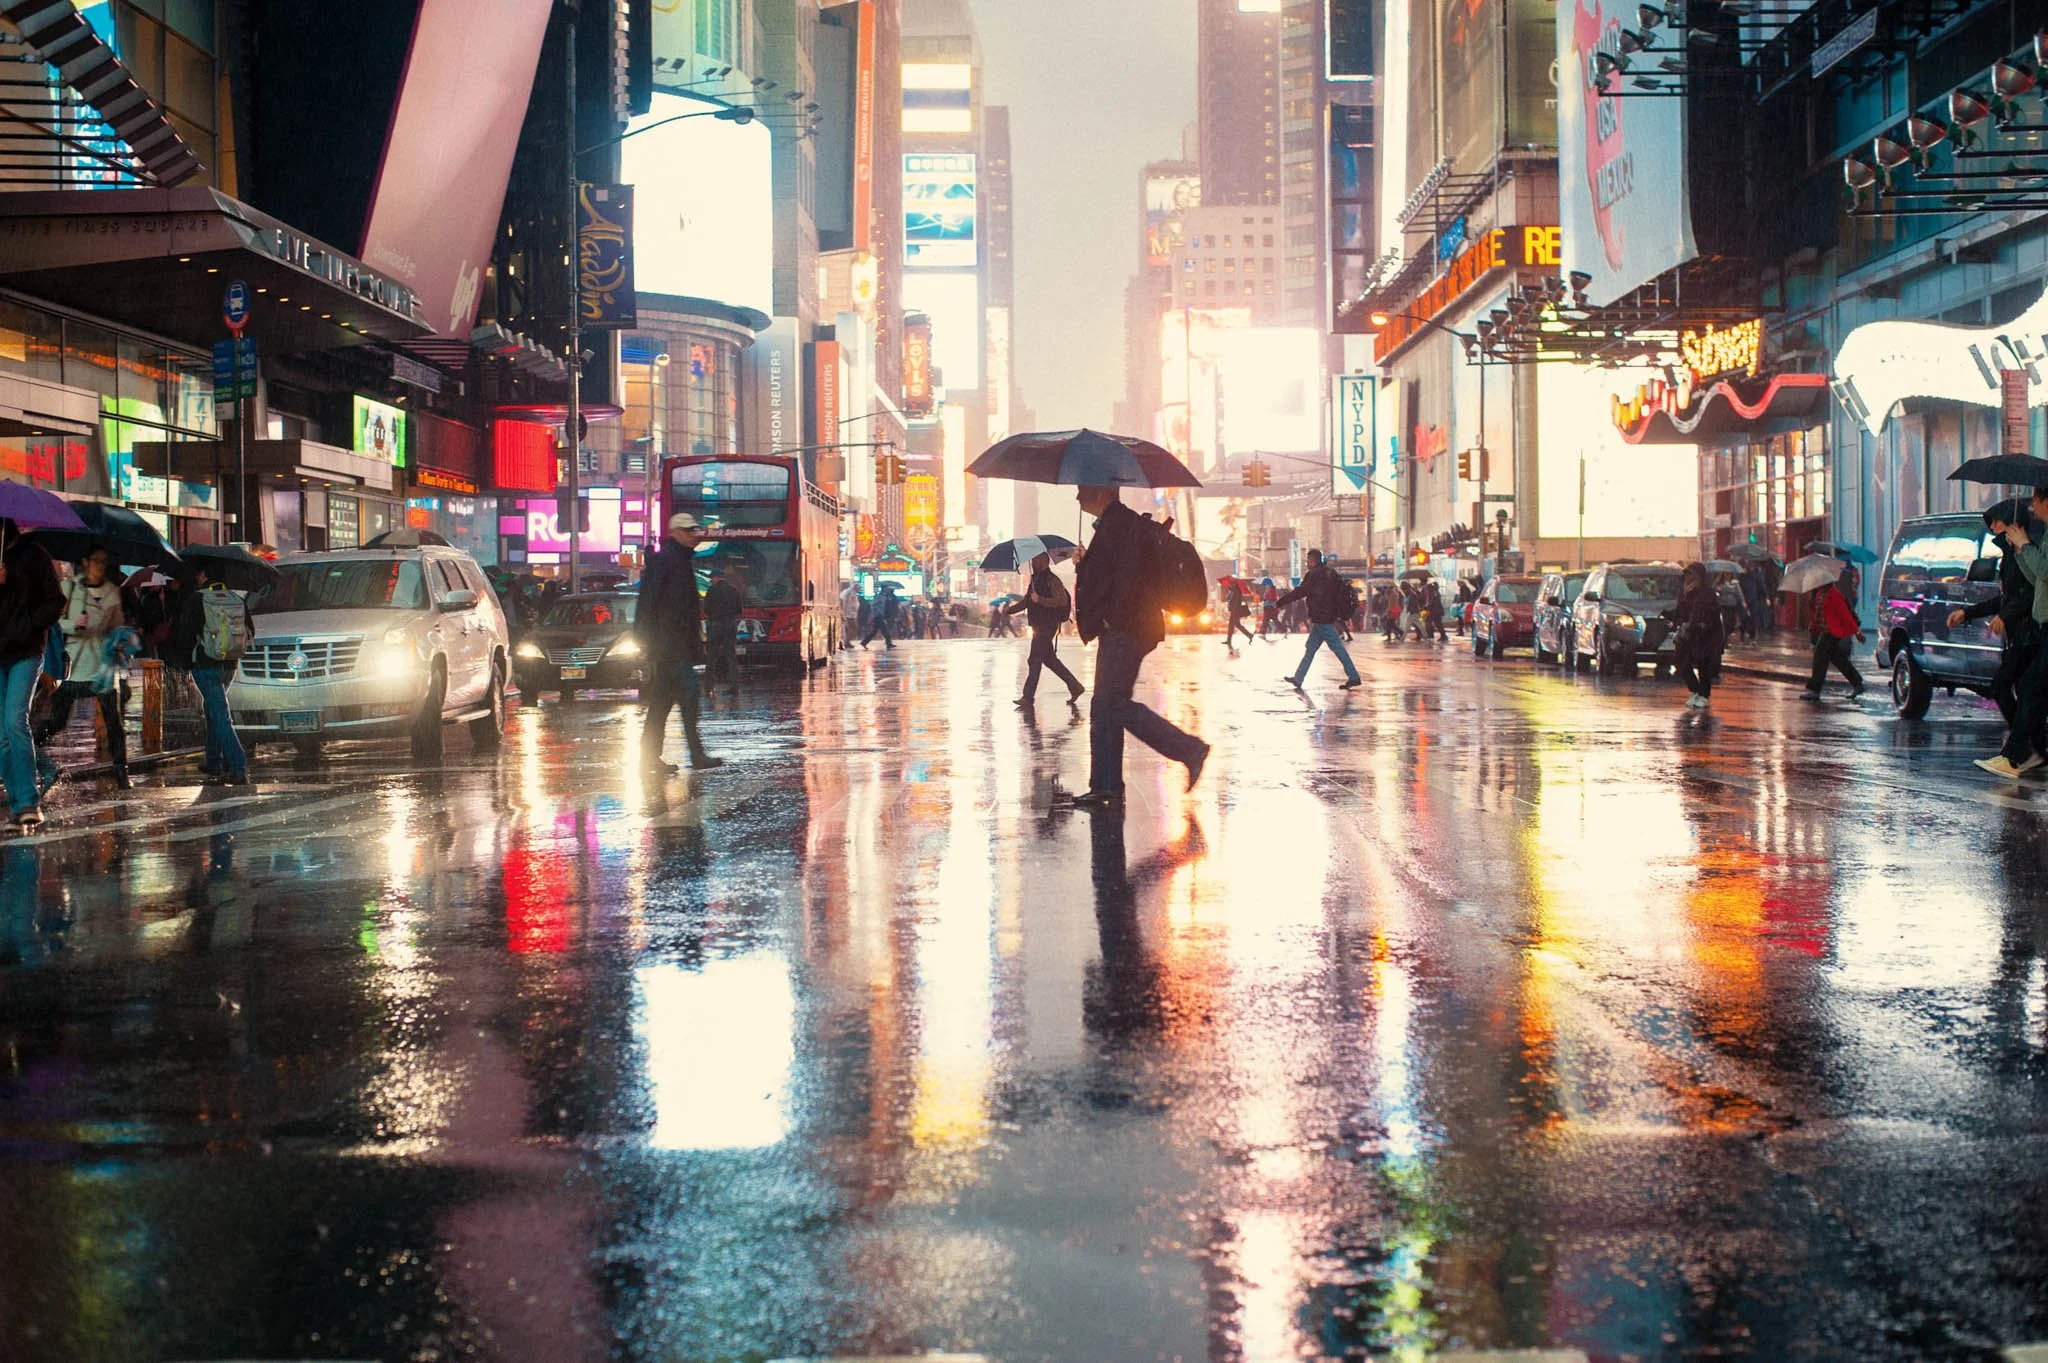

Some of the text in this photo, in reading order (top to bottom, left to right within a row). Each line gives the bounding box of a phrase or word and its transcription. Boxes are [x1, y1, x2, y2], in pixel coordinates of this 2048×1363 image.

[1597, 96, 1617, 145] USA
[276, 228, 310, 270] FIVE
[320, 249, 360, 296] TIMES
[770, 350, 781, 407] REUTERS
[824, 363, 833, 408] REUTERS
[1351, 381, 1366, 465] NYPD
[706, 526, 726, 537] York
[727, 526, 769, 539] Sightseeing
